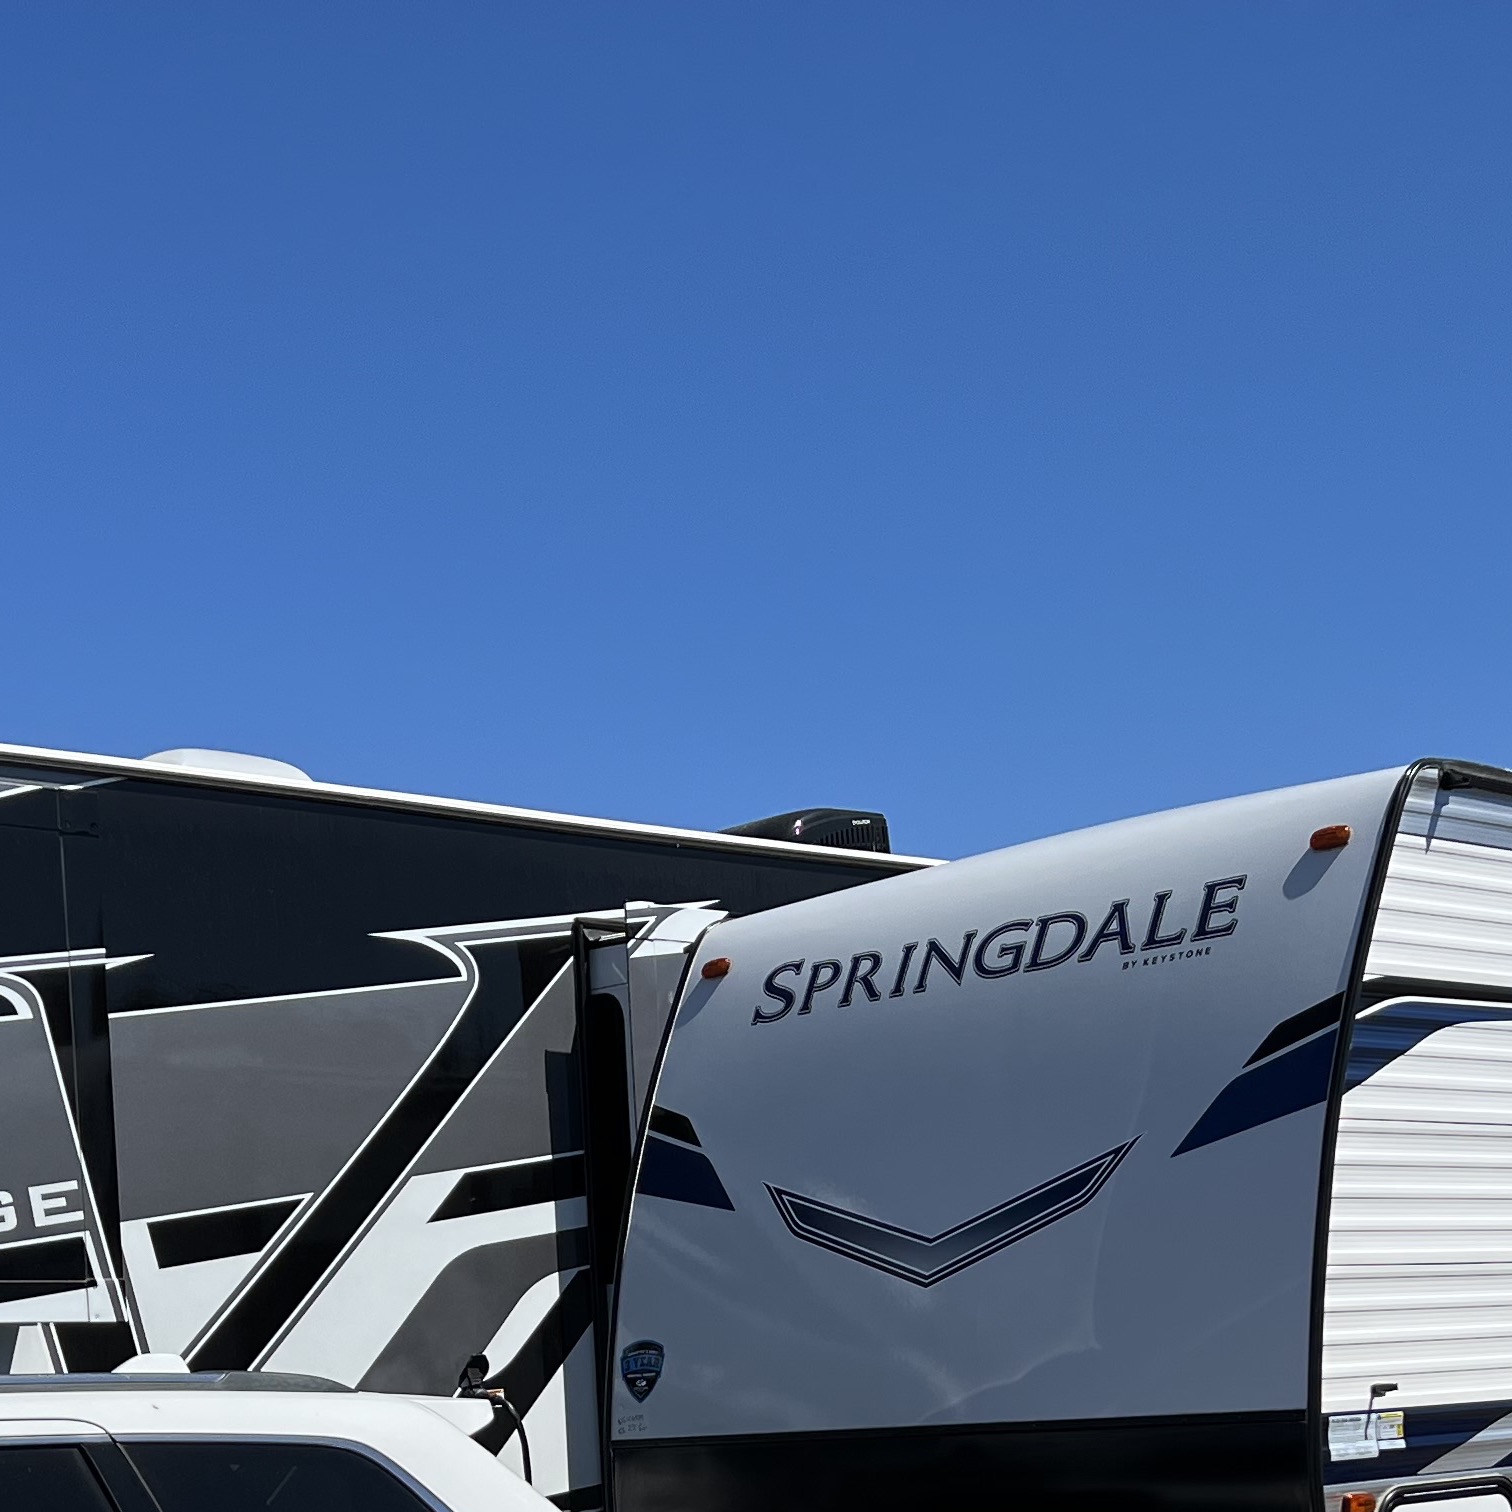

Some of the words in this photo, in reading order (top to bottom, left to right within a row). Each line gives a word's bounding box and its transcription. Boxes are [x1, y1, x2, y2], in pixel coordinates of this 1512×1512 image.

[750, 874, 1247, 1026] SPRINGDALE
[1122, 959, 1137, 971] BY
[1142, 946, 1212, 966] KEYSTONE
